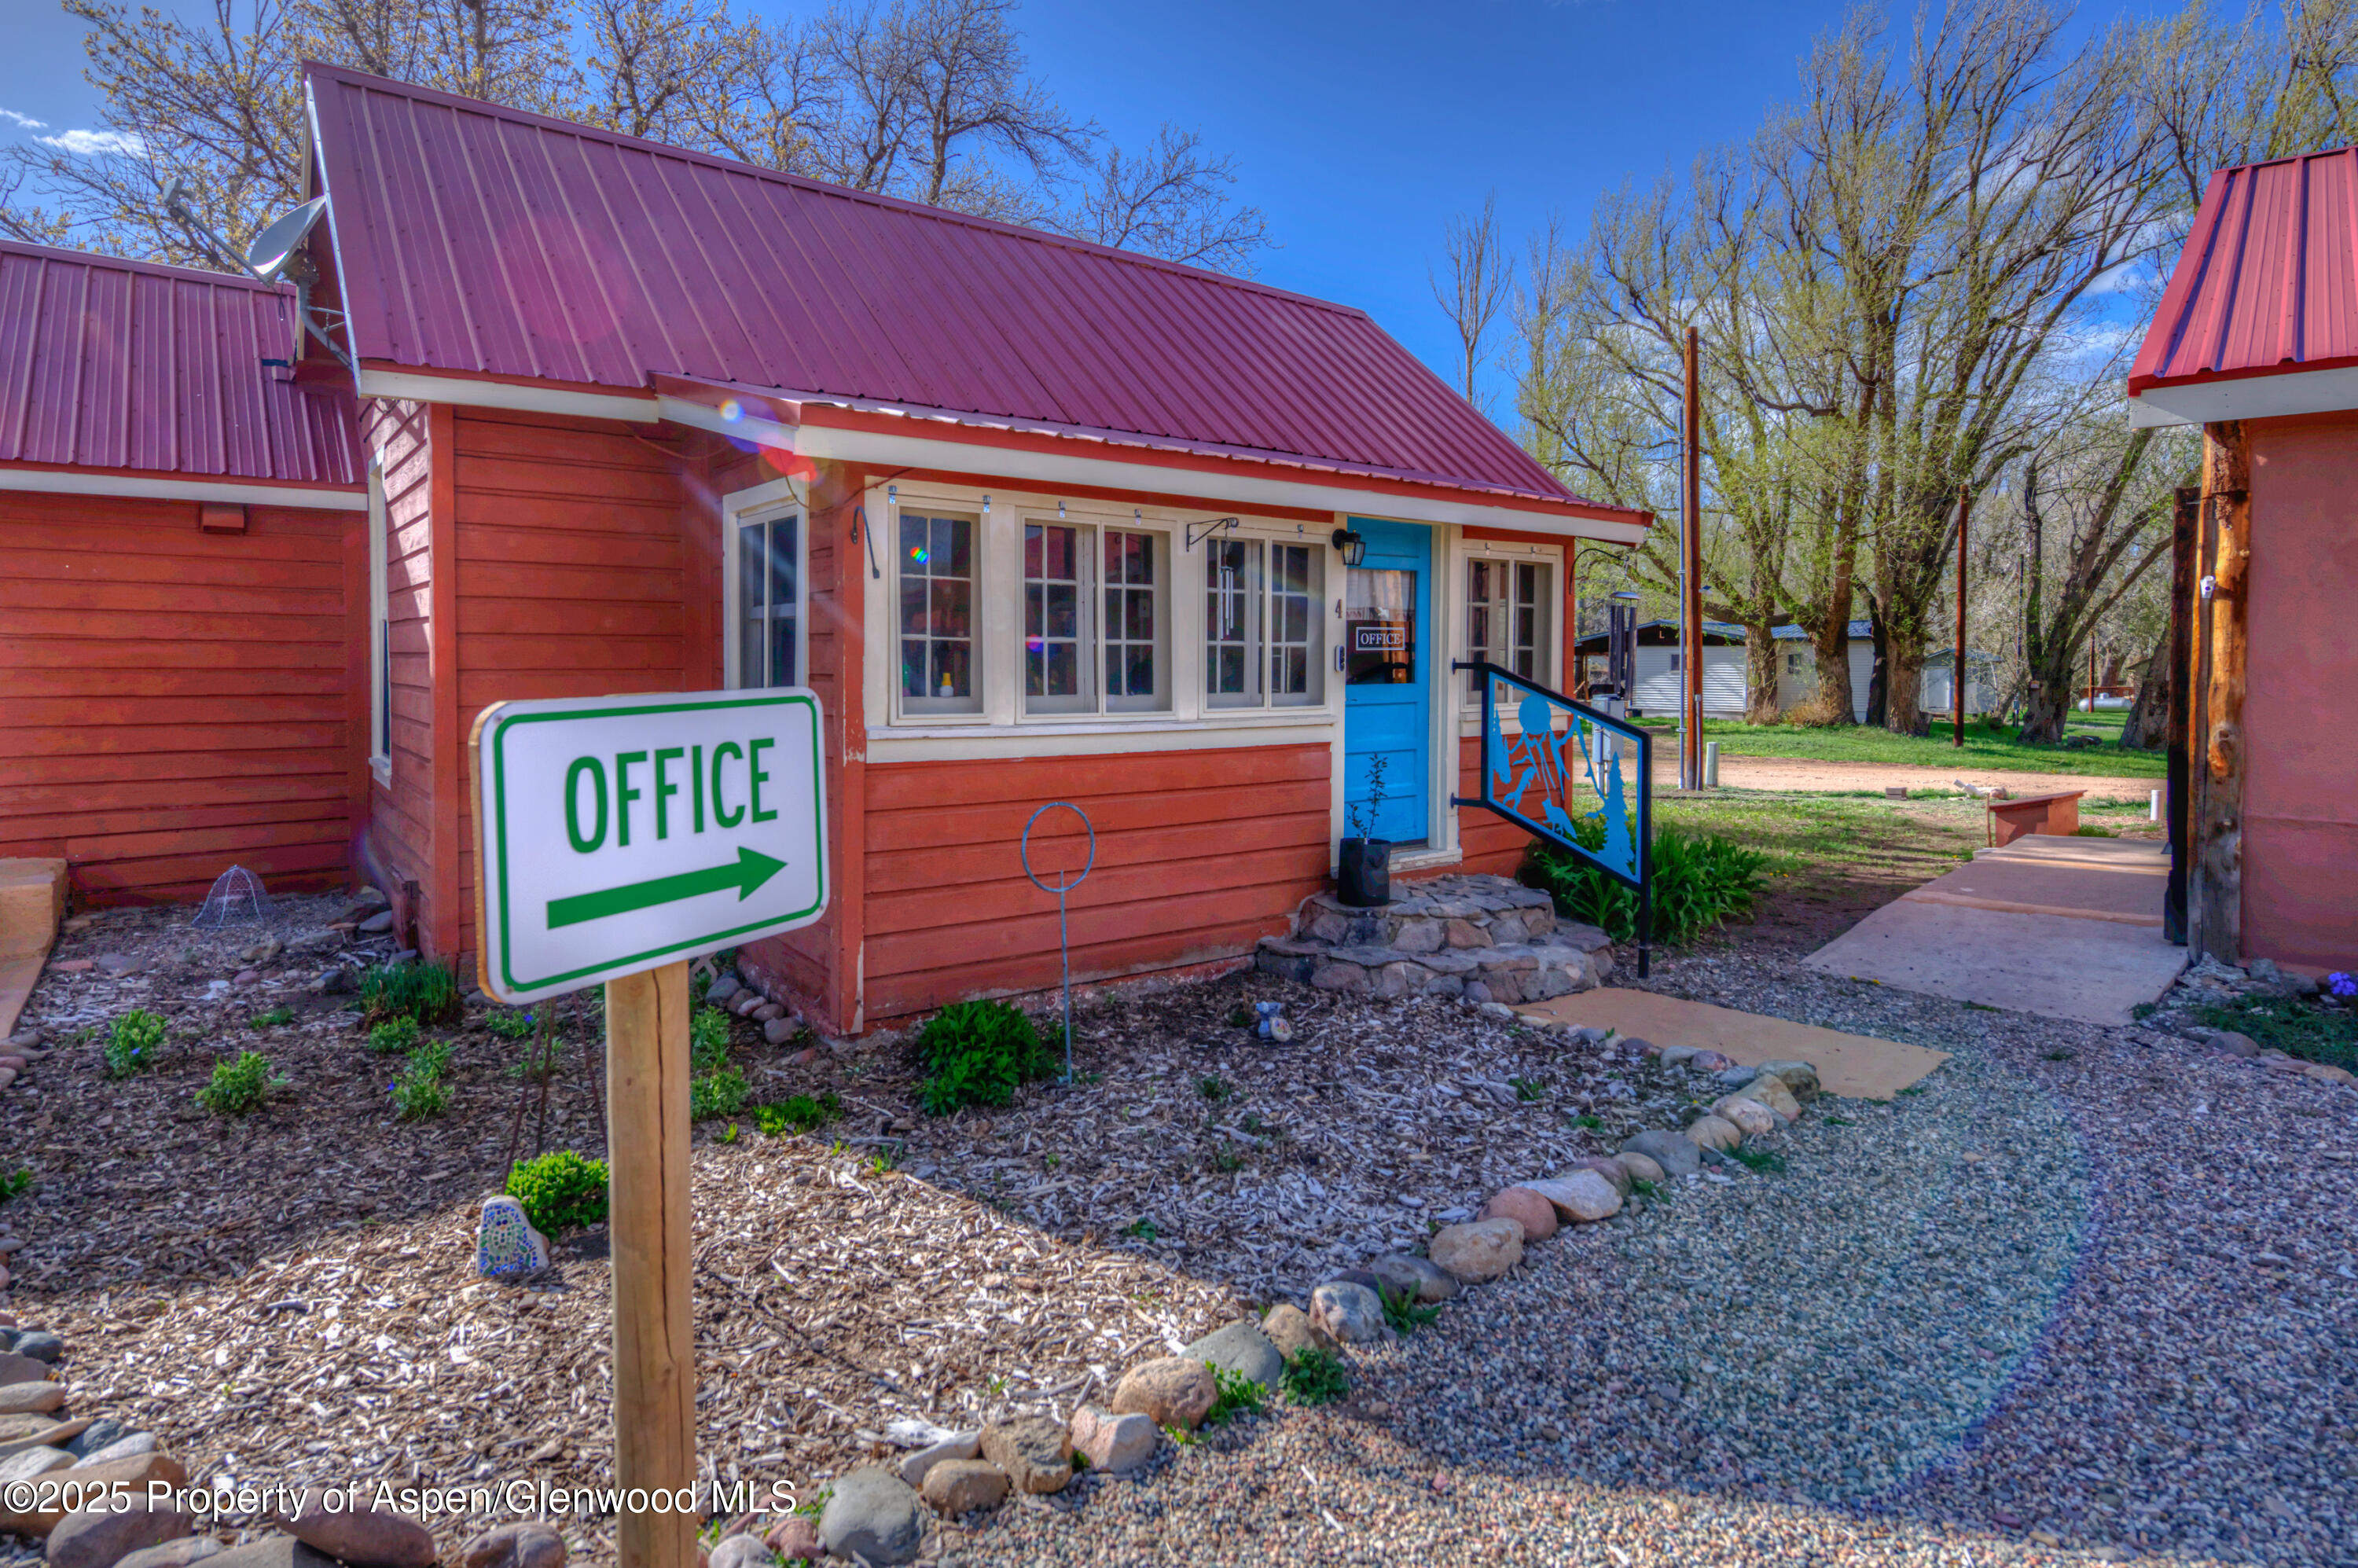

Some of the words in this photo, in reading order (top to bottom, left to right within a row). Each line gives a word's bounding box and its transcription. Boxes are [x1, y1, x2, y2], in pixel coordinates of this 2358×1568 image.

[1335, 599, 1342, 619] 4
[1360, 633, 1401, 645] OFFICE
[564, 737, 778, 854] OFFICE
